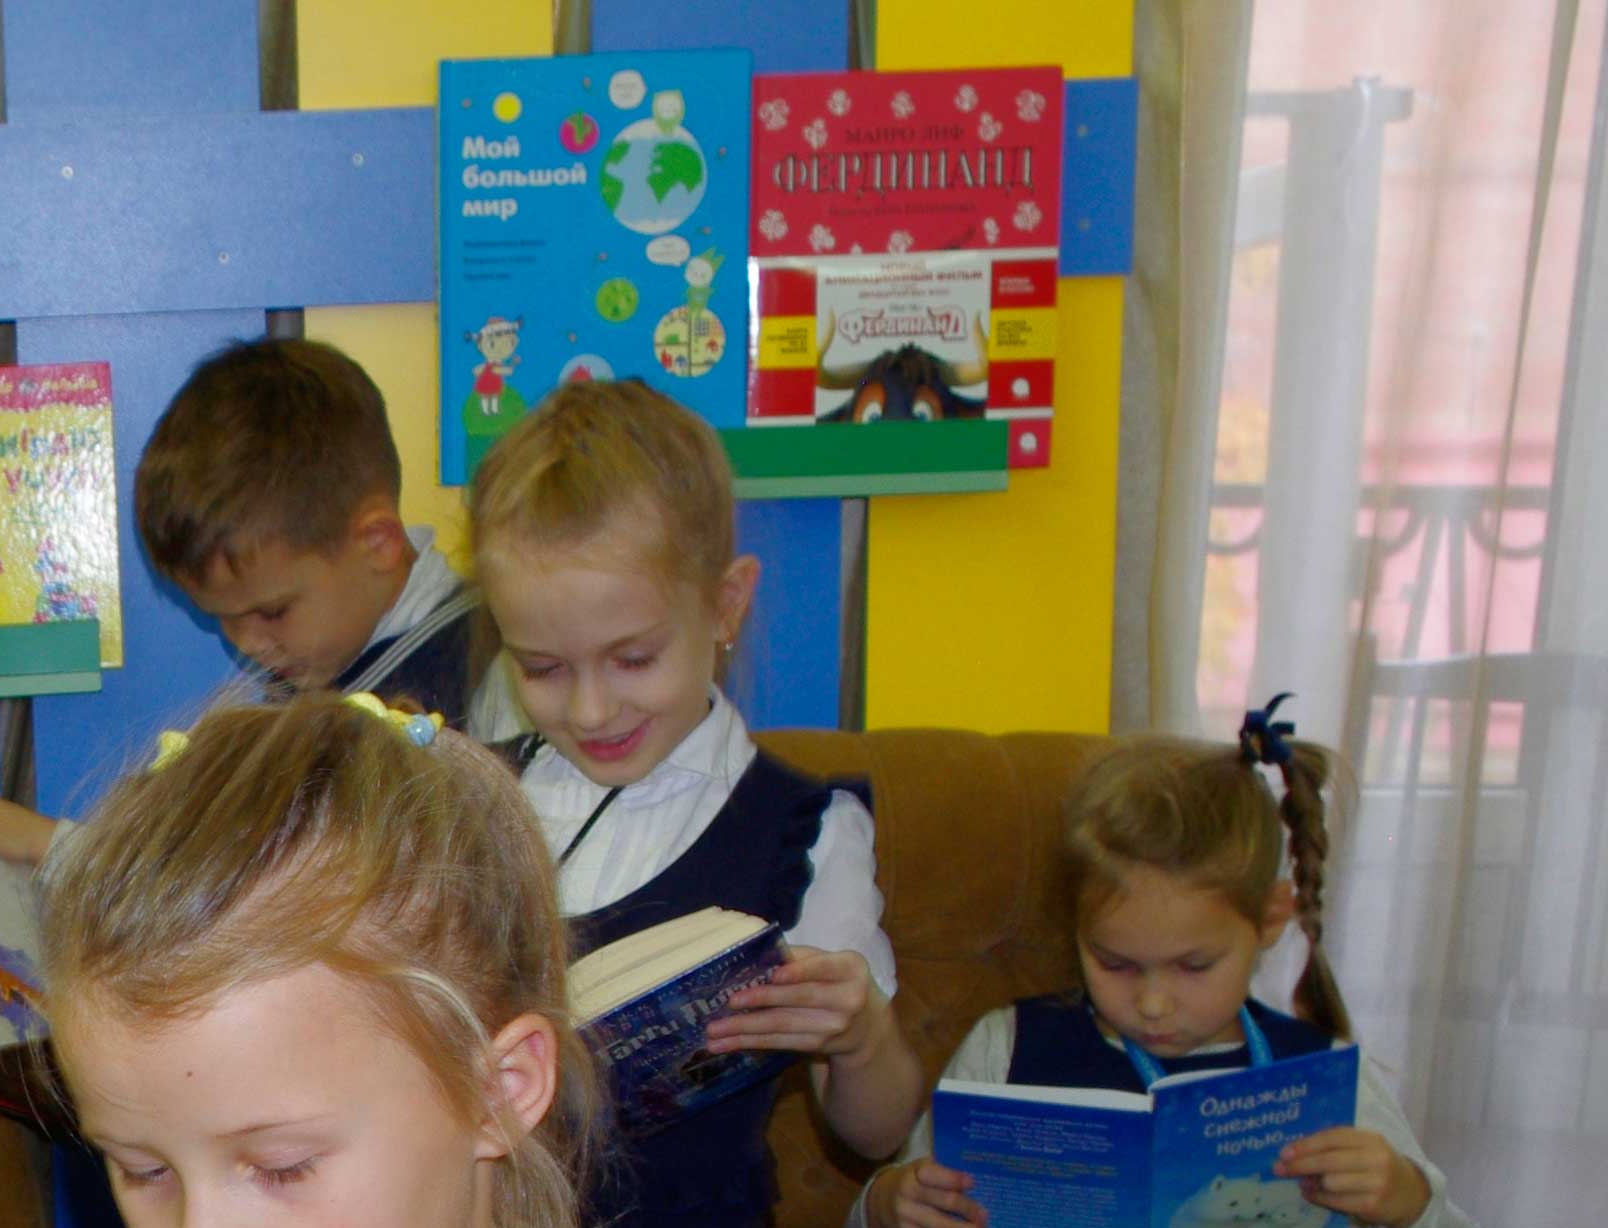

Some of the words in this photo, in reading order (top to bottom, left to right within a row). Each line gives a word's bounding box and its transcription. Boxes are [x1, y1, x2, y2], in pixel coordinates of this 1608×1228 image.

[462, 135, 521, 160] Мой
[462, 162, 588, 190] большой
[772, 146, 1036, 198] ФЕРДИНАНД
[462, 198, 518, 222] мир
[1200, 1082, 1308, 1117] Однажды
[1203, 1102, 1300, 1138] снежной
